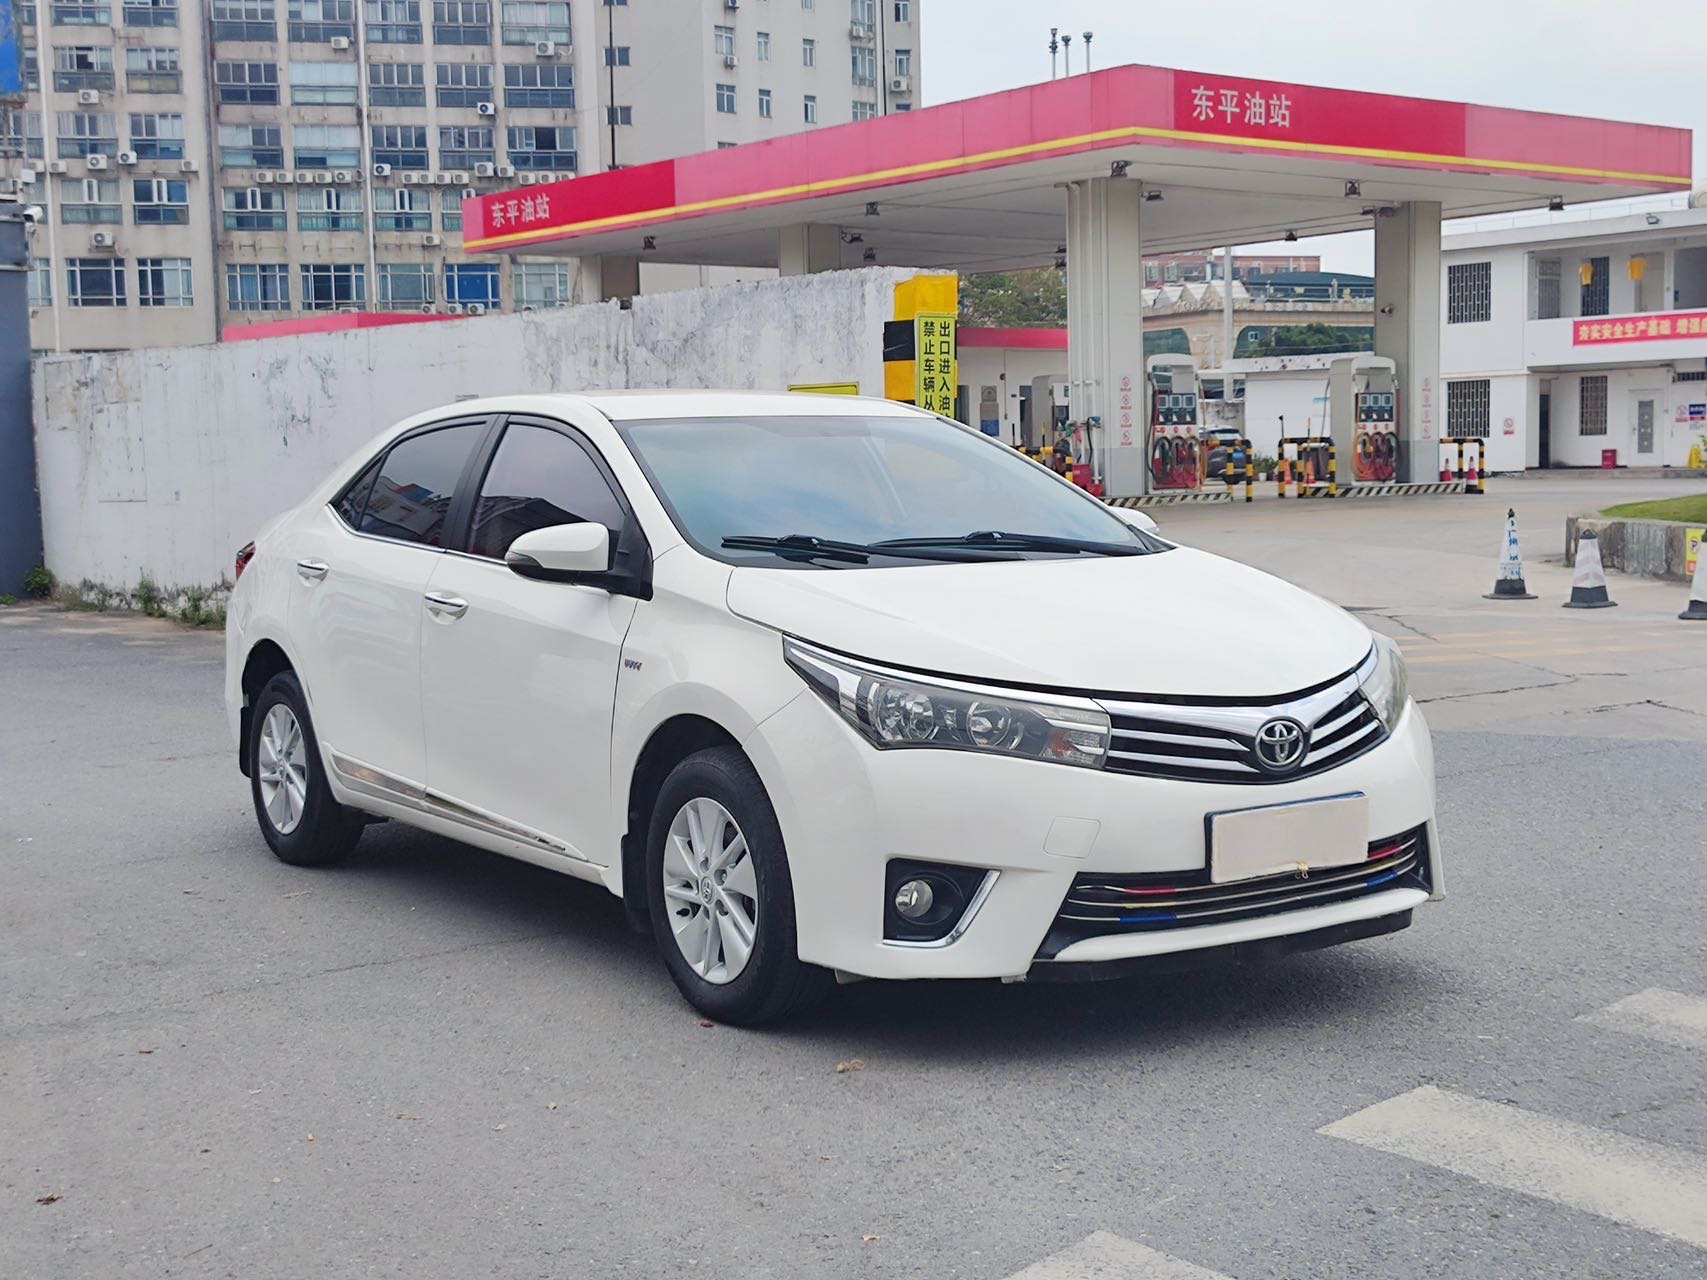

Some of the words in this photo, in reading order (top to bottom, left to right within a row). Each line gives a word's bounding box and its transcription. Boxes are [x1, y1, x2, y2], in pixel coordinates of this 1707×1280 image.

[1191, 85, 1292, 128] 东平油站
[491, 192, 550, 228] 东平油站
[923, 320, 936, 411] 禁止车辆从
[938, 320, 951, 418] 出口进入油
